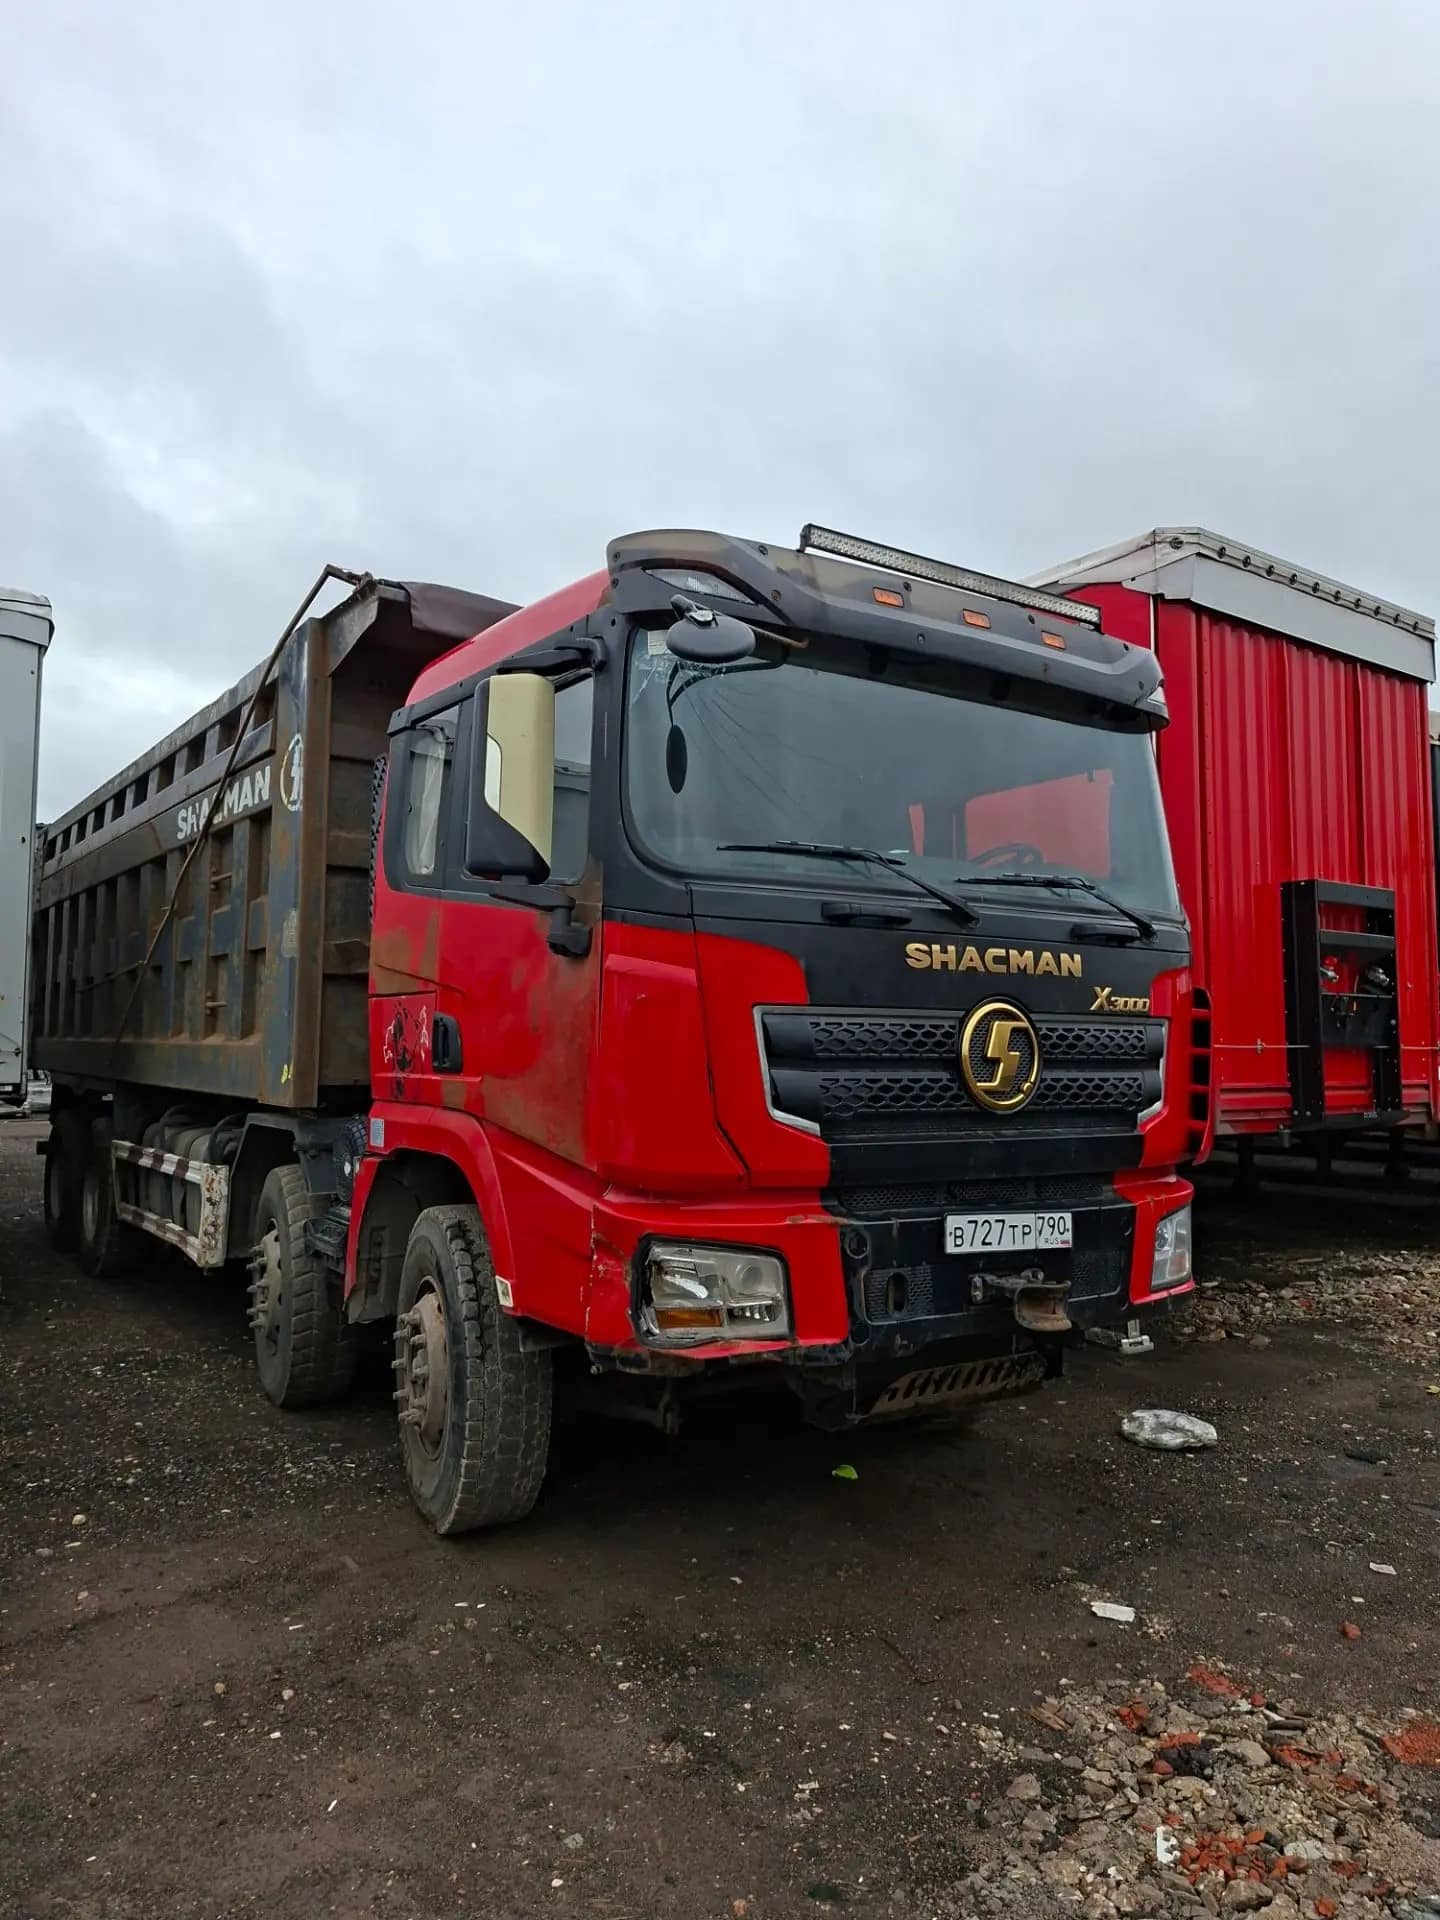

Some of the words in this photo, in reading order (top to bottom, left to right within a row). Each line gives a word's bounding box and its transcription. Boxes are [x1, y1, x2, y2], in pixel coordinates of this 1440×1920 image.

[905, 943, 1082, 977] SHACMAN
[1090, 986, 1150, 1012] X3000
[1036, 1216, 1067, 1237] 790
